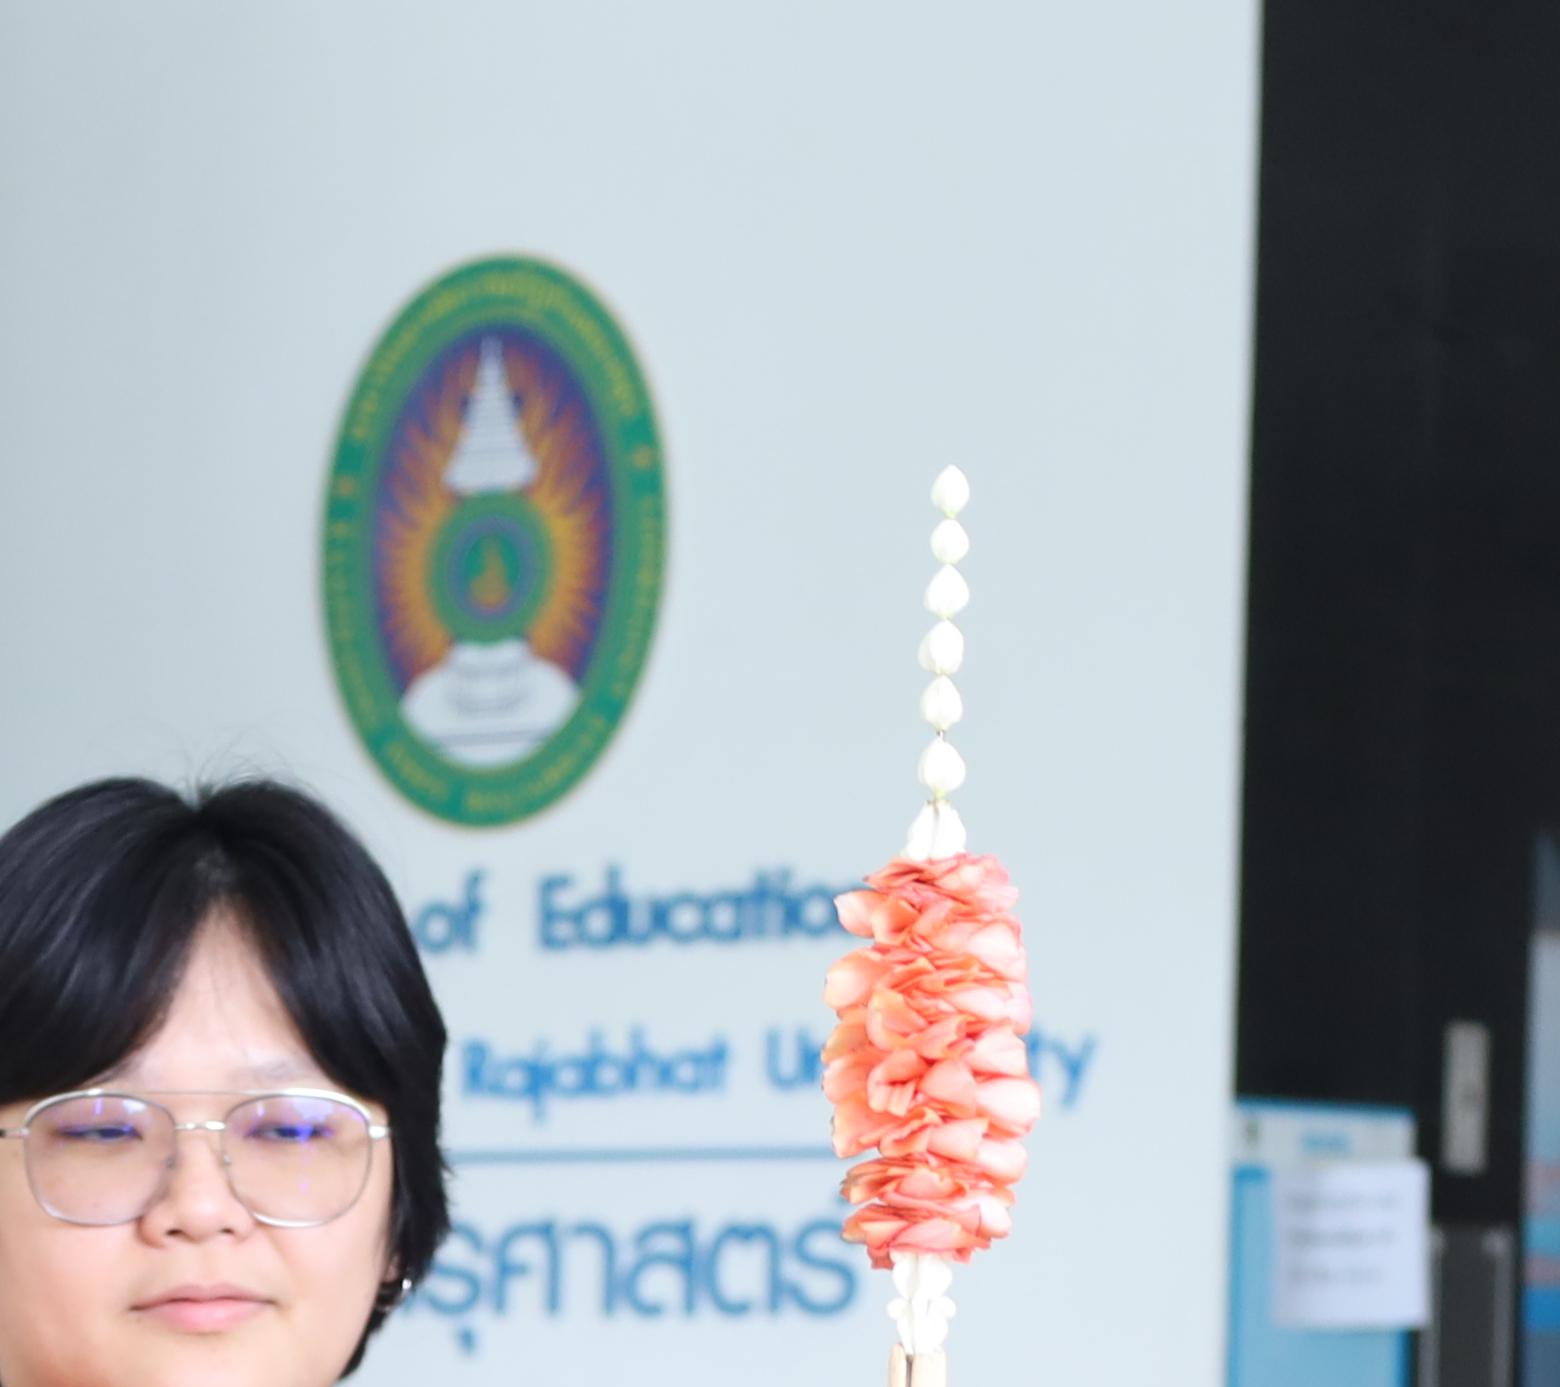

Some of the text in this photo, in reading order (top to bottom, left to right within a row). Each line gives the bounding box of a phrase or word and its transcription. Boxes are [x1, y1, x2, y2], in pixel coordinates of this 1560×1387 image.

[410, 867, 865, 954] of Educatio
[462, 1030, 731, 1117] Rajabhat
